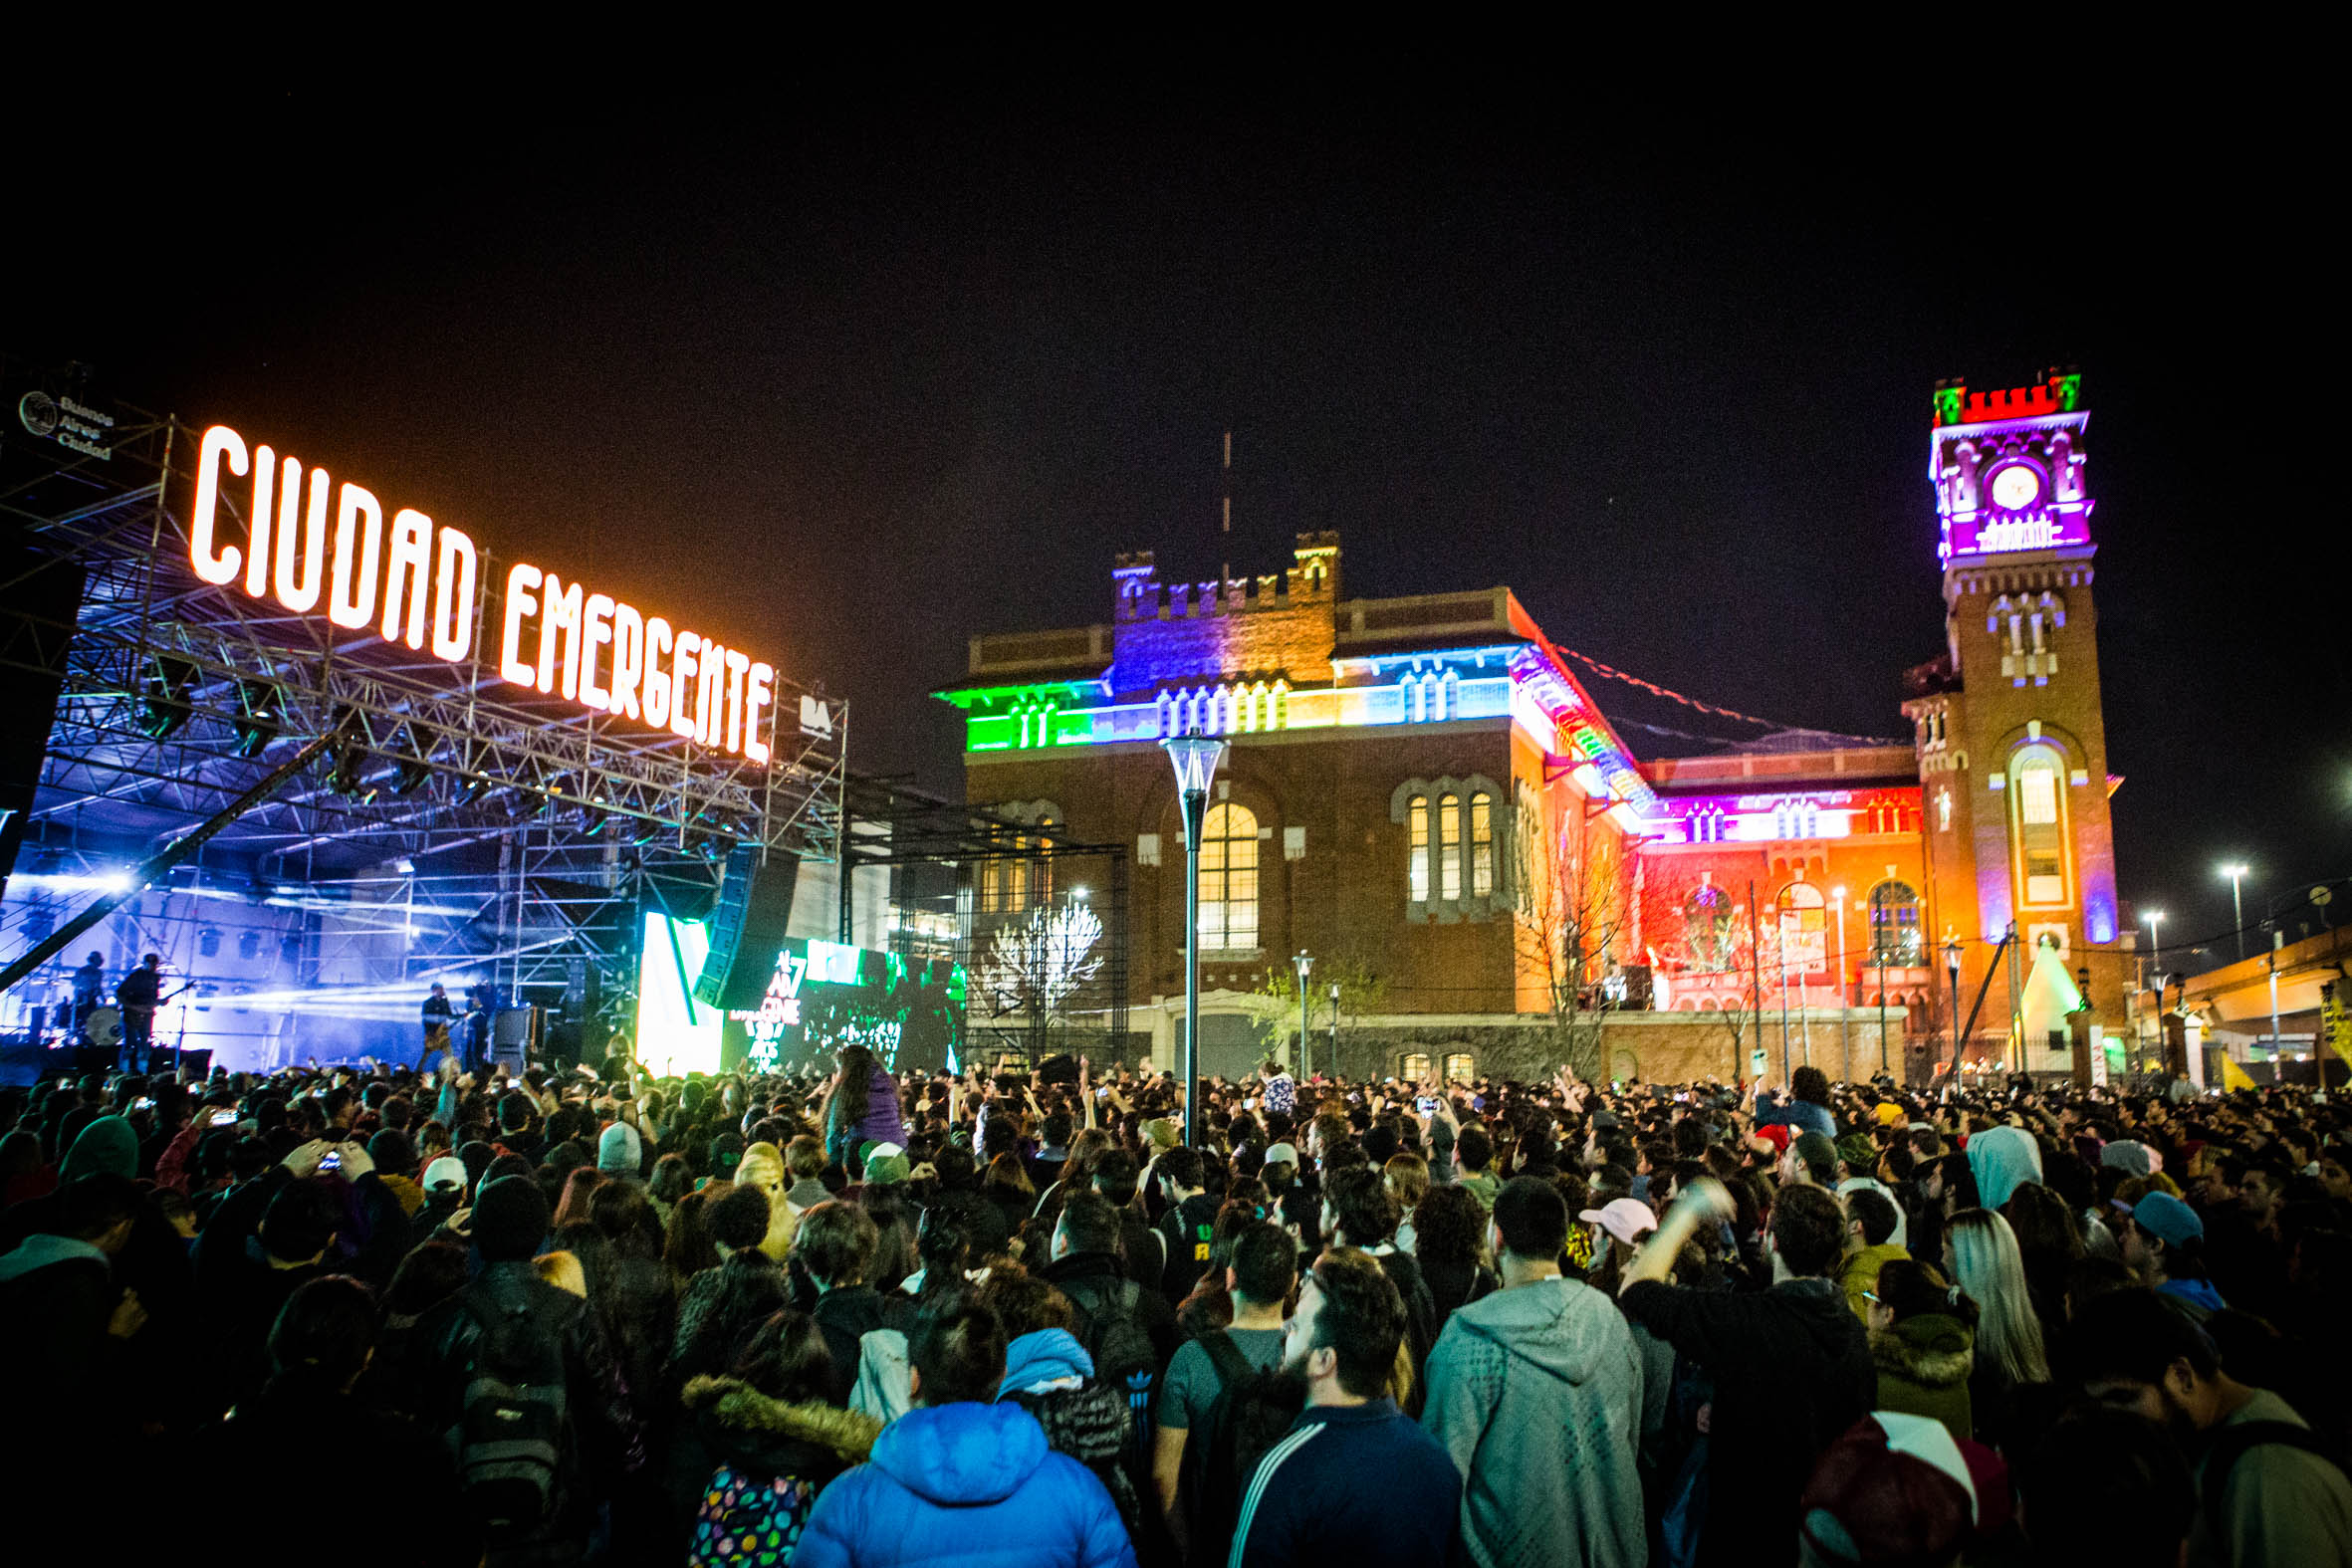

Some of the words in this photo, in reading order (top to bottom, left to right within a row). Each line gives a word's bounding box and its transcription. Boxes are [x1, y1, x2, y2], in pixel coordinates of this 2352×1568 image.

[61, 396, 114, 427] Buenos
[60, 415, 101, 440] Aires
[59, 433, 112, 461] Ciudad
[190, 425, 477, 663] CIUDAD
[501, 562, 774, 765] EMERGENTE
